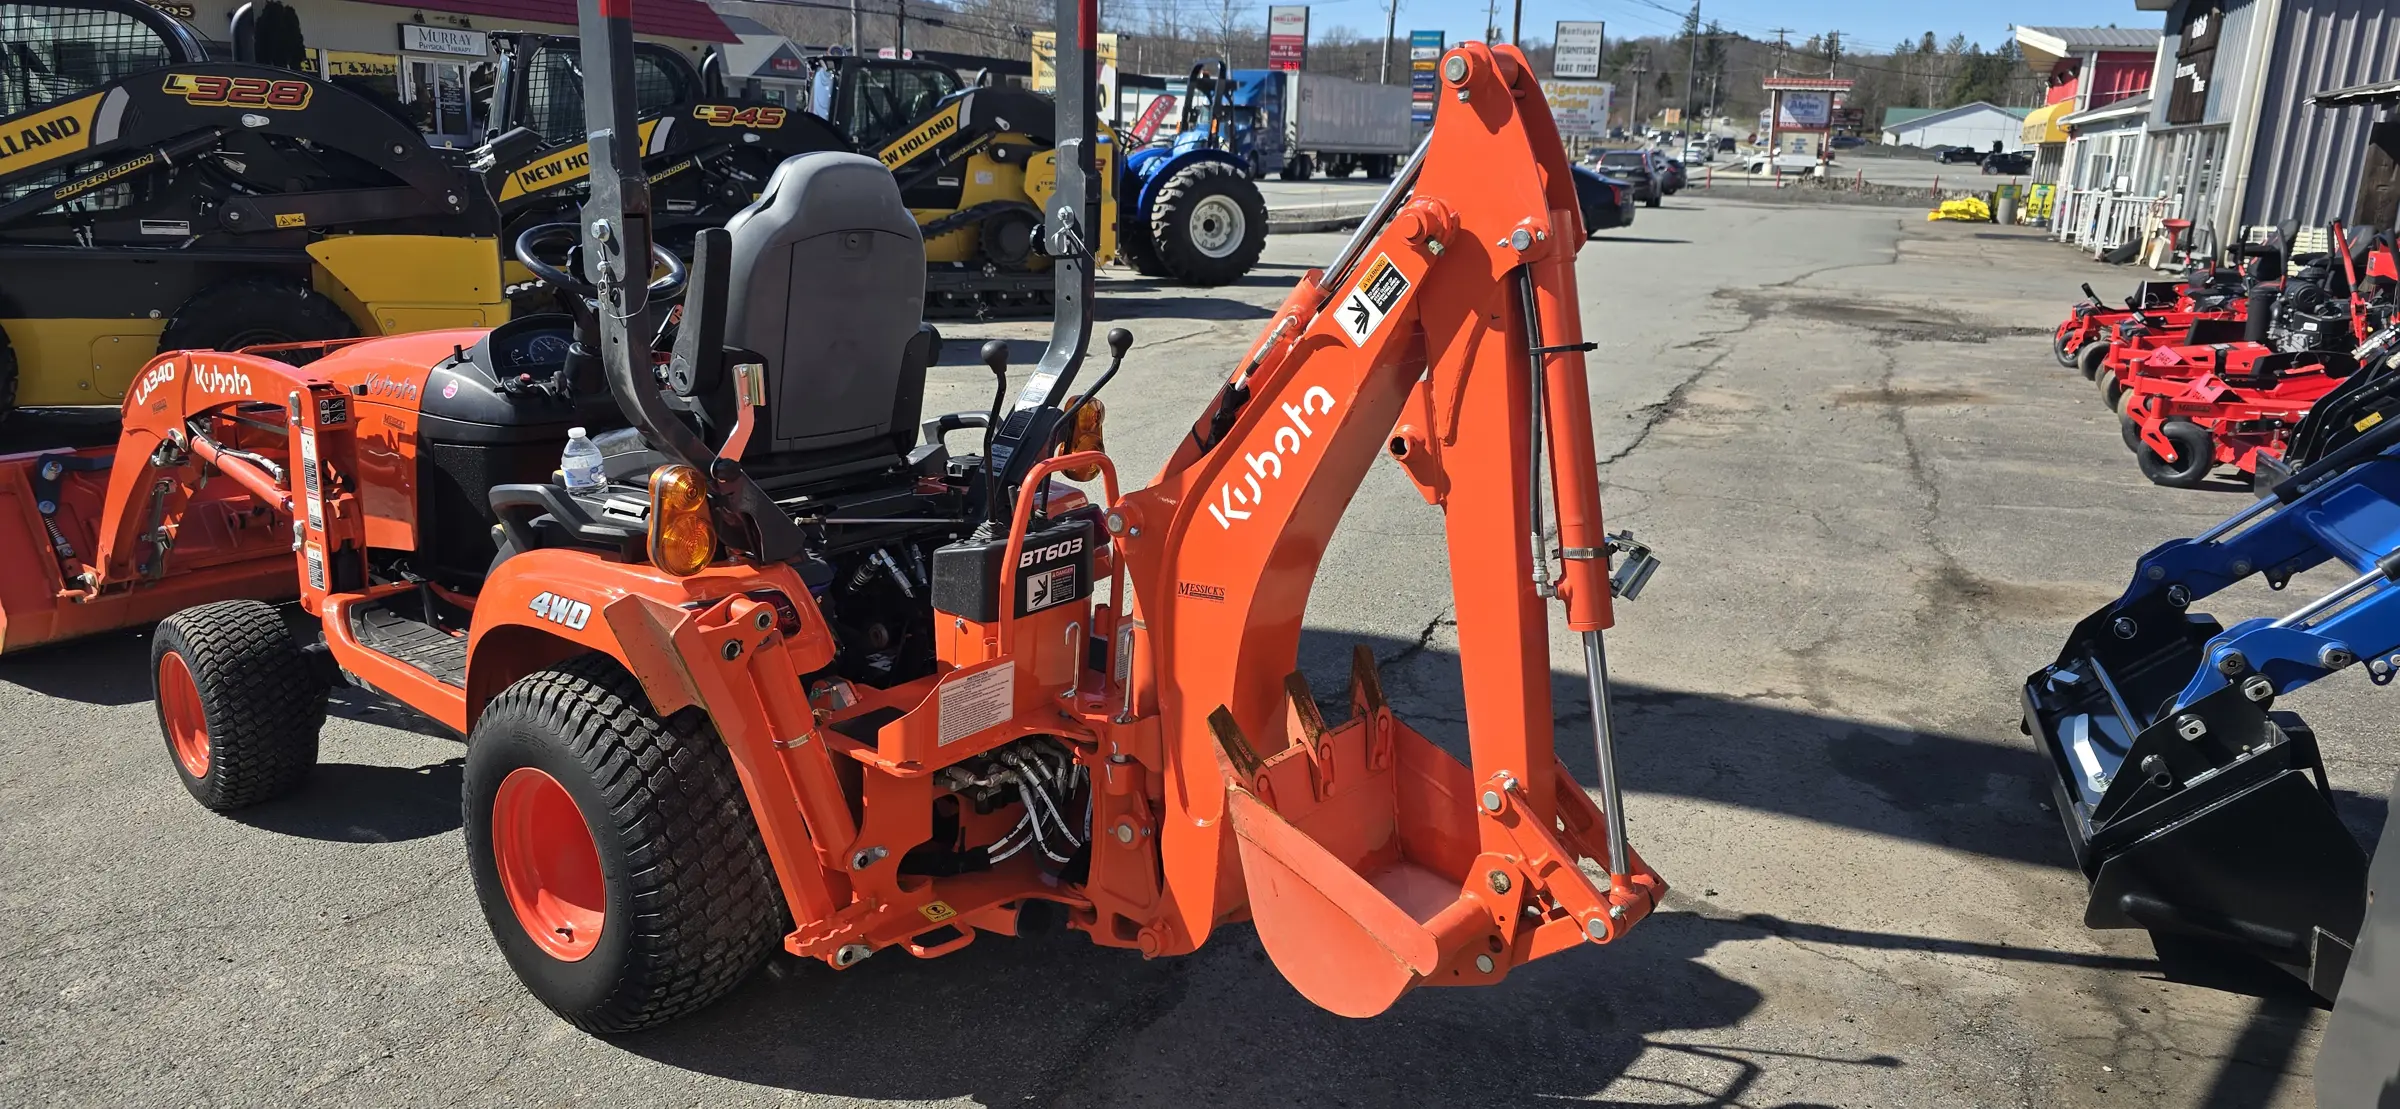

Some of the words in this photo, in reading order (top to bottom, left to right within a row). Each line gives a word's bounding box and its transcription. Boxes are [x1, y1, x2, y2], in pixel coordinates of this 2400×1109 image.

[419, 28, 472, 46] MURRAY
[1558, 46, 1597, 55] FURNITURE
[163, 74, 313, 110] L328
[1544, 82, 1604, 97] Cigarette
[1548, 96, 1590, 109] Outlet
[693, 104, 786, 128] C345
[898, 115, 955, 157] HOLLAND
[55, 171, 107, 199] SUPER
[107, 153, 154, 179] BOOM
[521, 160, 563, 185] NEW
[1367, 259, 1386, 283] WARNING
[135, 362, 174, 405] LA340
[194, 364, 252, 396] Kubota
[365, 372, 417, 401] Kubota
[1208, 386, 1336, 530] Kubota
[1019, 538, 1083, 568] BT603
[1178, 582, 1226, 596] MESSICK'S
[529, 591, 592, 631] 4WD
